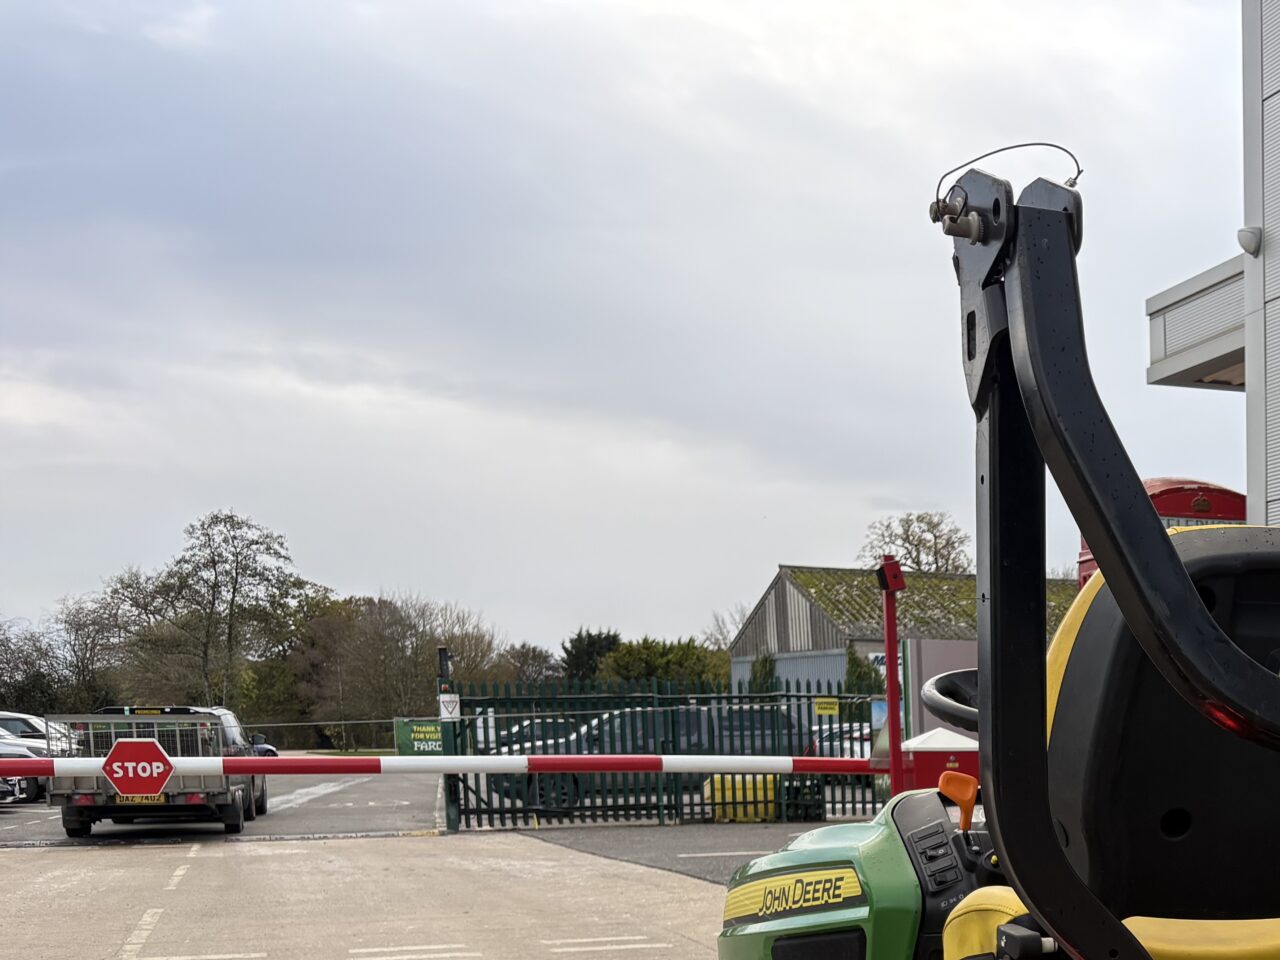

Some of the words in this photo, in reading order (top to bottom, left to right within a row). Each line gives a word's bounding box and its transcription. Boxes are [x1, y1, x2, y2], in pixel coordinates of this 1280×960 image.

[411, 732, 425, 740] FOR
[111, 761, 165, 778] STOP
[758, 885, 791, 914] JOHN
[792, 876, 845, 906] DEERE
